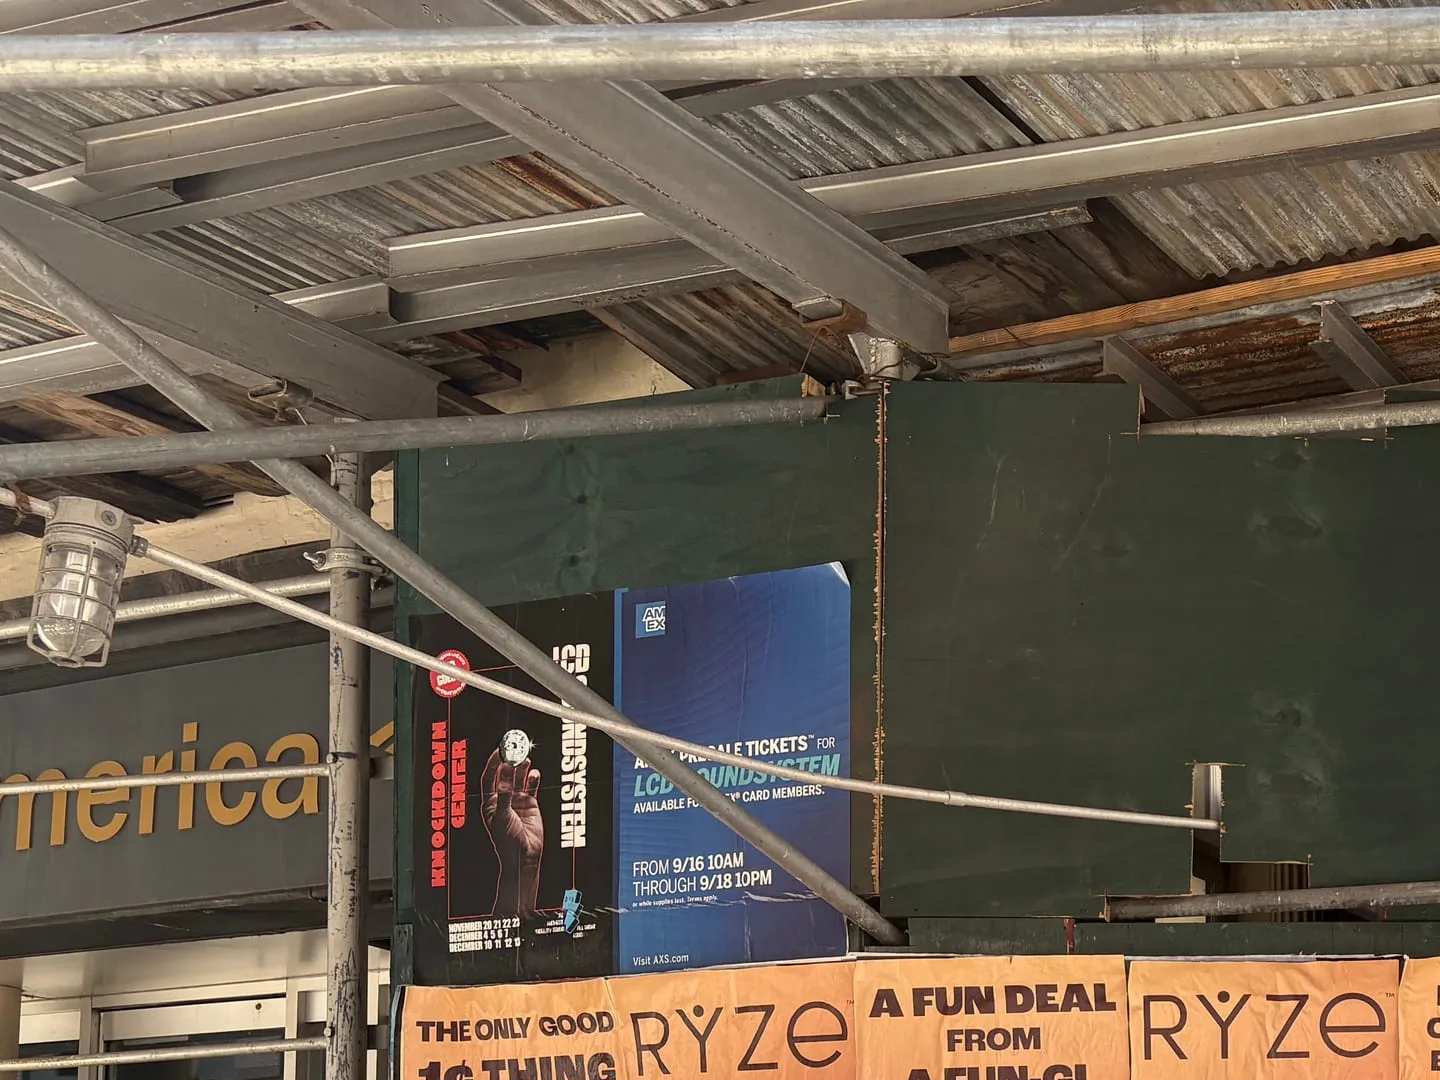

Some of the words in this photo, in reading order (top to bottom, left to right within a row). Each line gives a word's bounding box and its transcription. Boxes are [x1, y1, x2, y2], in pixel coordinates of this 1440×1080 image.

[642, 605, 666, 621] AM
[646, 619, 666, 632] EX
[816, 736, 836, 750] FOR
[431, 720, 449, 888] KNOCKDOWN
[633, 799, 685, 814] AVAILABLE
[742, 788, 770, 802] CARD
[772, 784, 825, 799] MEMBERS.
[632, 859, 670, 877] FROM
[672, 855, 705, 875] 9/16
[707, 851, 744, 871] 10AM
[632, 876, 697, 897] THROUGH
[699, 872, 732, 892] 9/18
[734, 869, 773, 888] 10PM
[448, 921, 483, 933] NOVEMBER
[483, 919, 492, 931] 20
[493, 918, 502, 930] 21
[502, 918, 512, 929] 22
[448, 931, 483, 943] DECEMBER
[483, 929, 489, 940] 4
[448, 941, 483, 953] DECEMBER
[484, 938, 493, 950] 10
[632, 957, 651, 967] Visit
[652, 954, 689, 965] AXS.com
[869, 988, 904, 1018] A
[912, 986, 995, 1016] FUN
[1011, 983, 1117, 1014] DEAL
[416, 1020, 471, 1042] THE
[474, 1016, 531, 1040] ONLY
[539, 1011, 614, 1035] GOOD
[946, 1027, 1042, 1052] FROM
